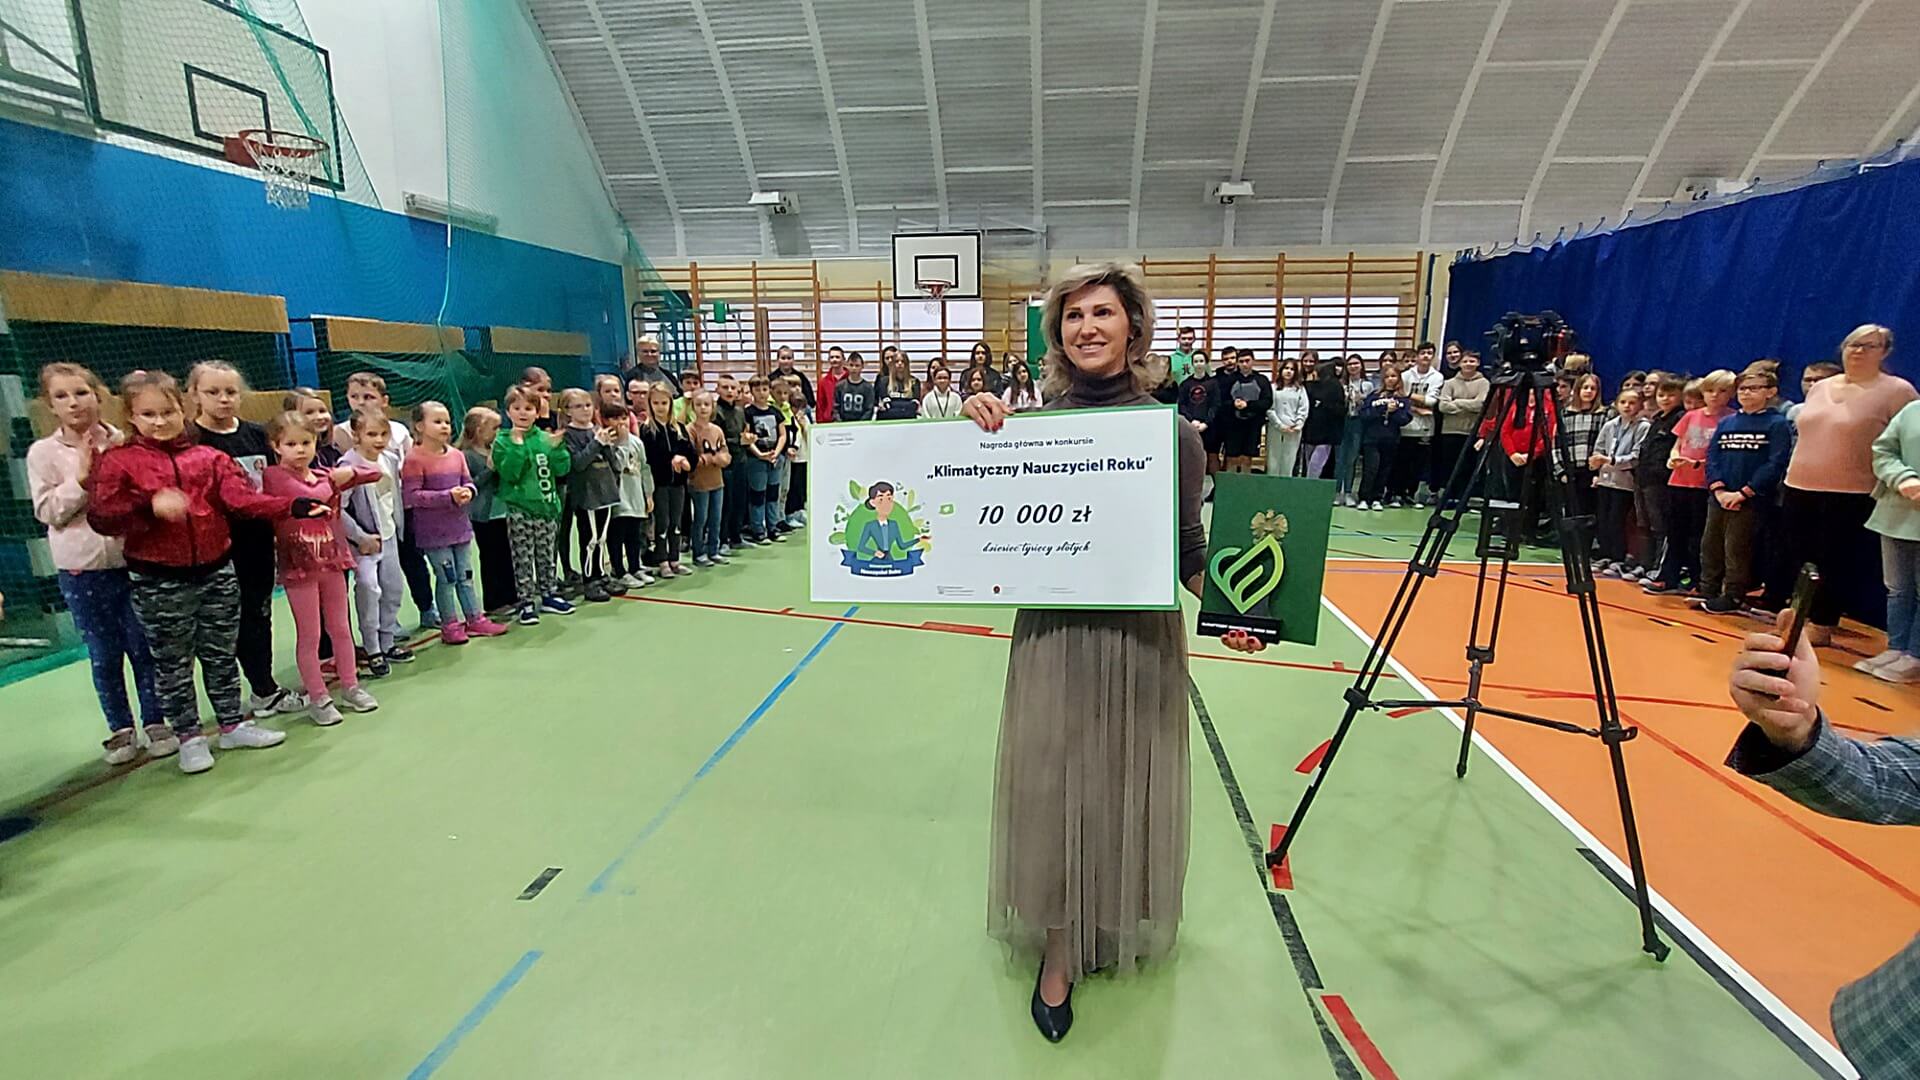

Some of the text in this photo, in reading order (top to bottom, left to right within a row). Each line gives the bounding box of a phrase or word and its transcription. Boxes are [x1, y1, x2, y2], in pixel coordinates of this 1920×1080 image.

[1220, 195, 1234, 205] L5
[979, 441, 1013, 450] Nagroda
[1014, 439, 1044, 449] główna
[1054, 437, 1094, 446] konkursie
[926, 464, 1020, 479] „Klimatyczny
[1023, 458, 1104, 475] Nauczyciel
[978, 504, 1093, 525] 10 000 zł
